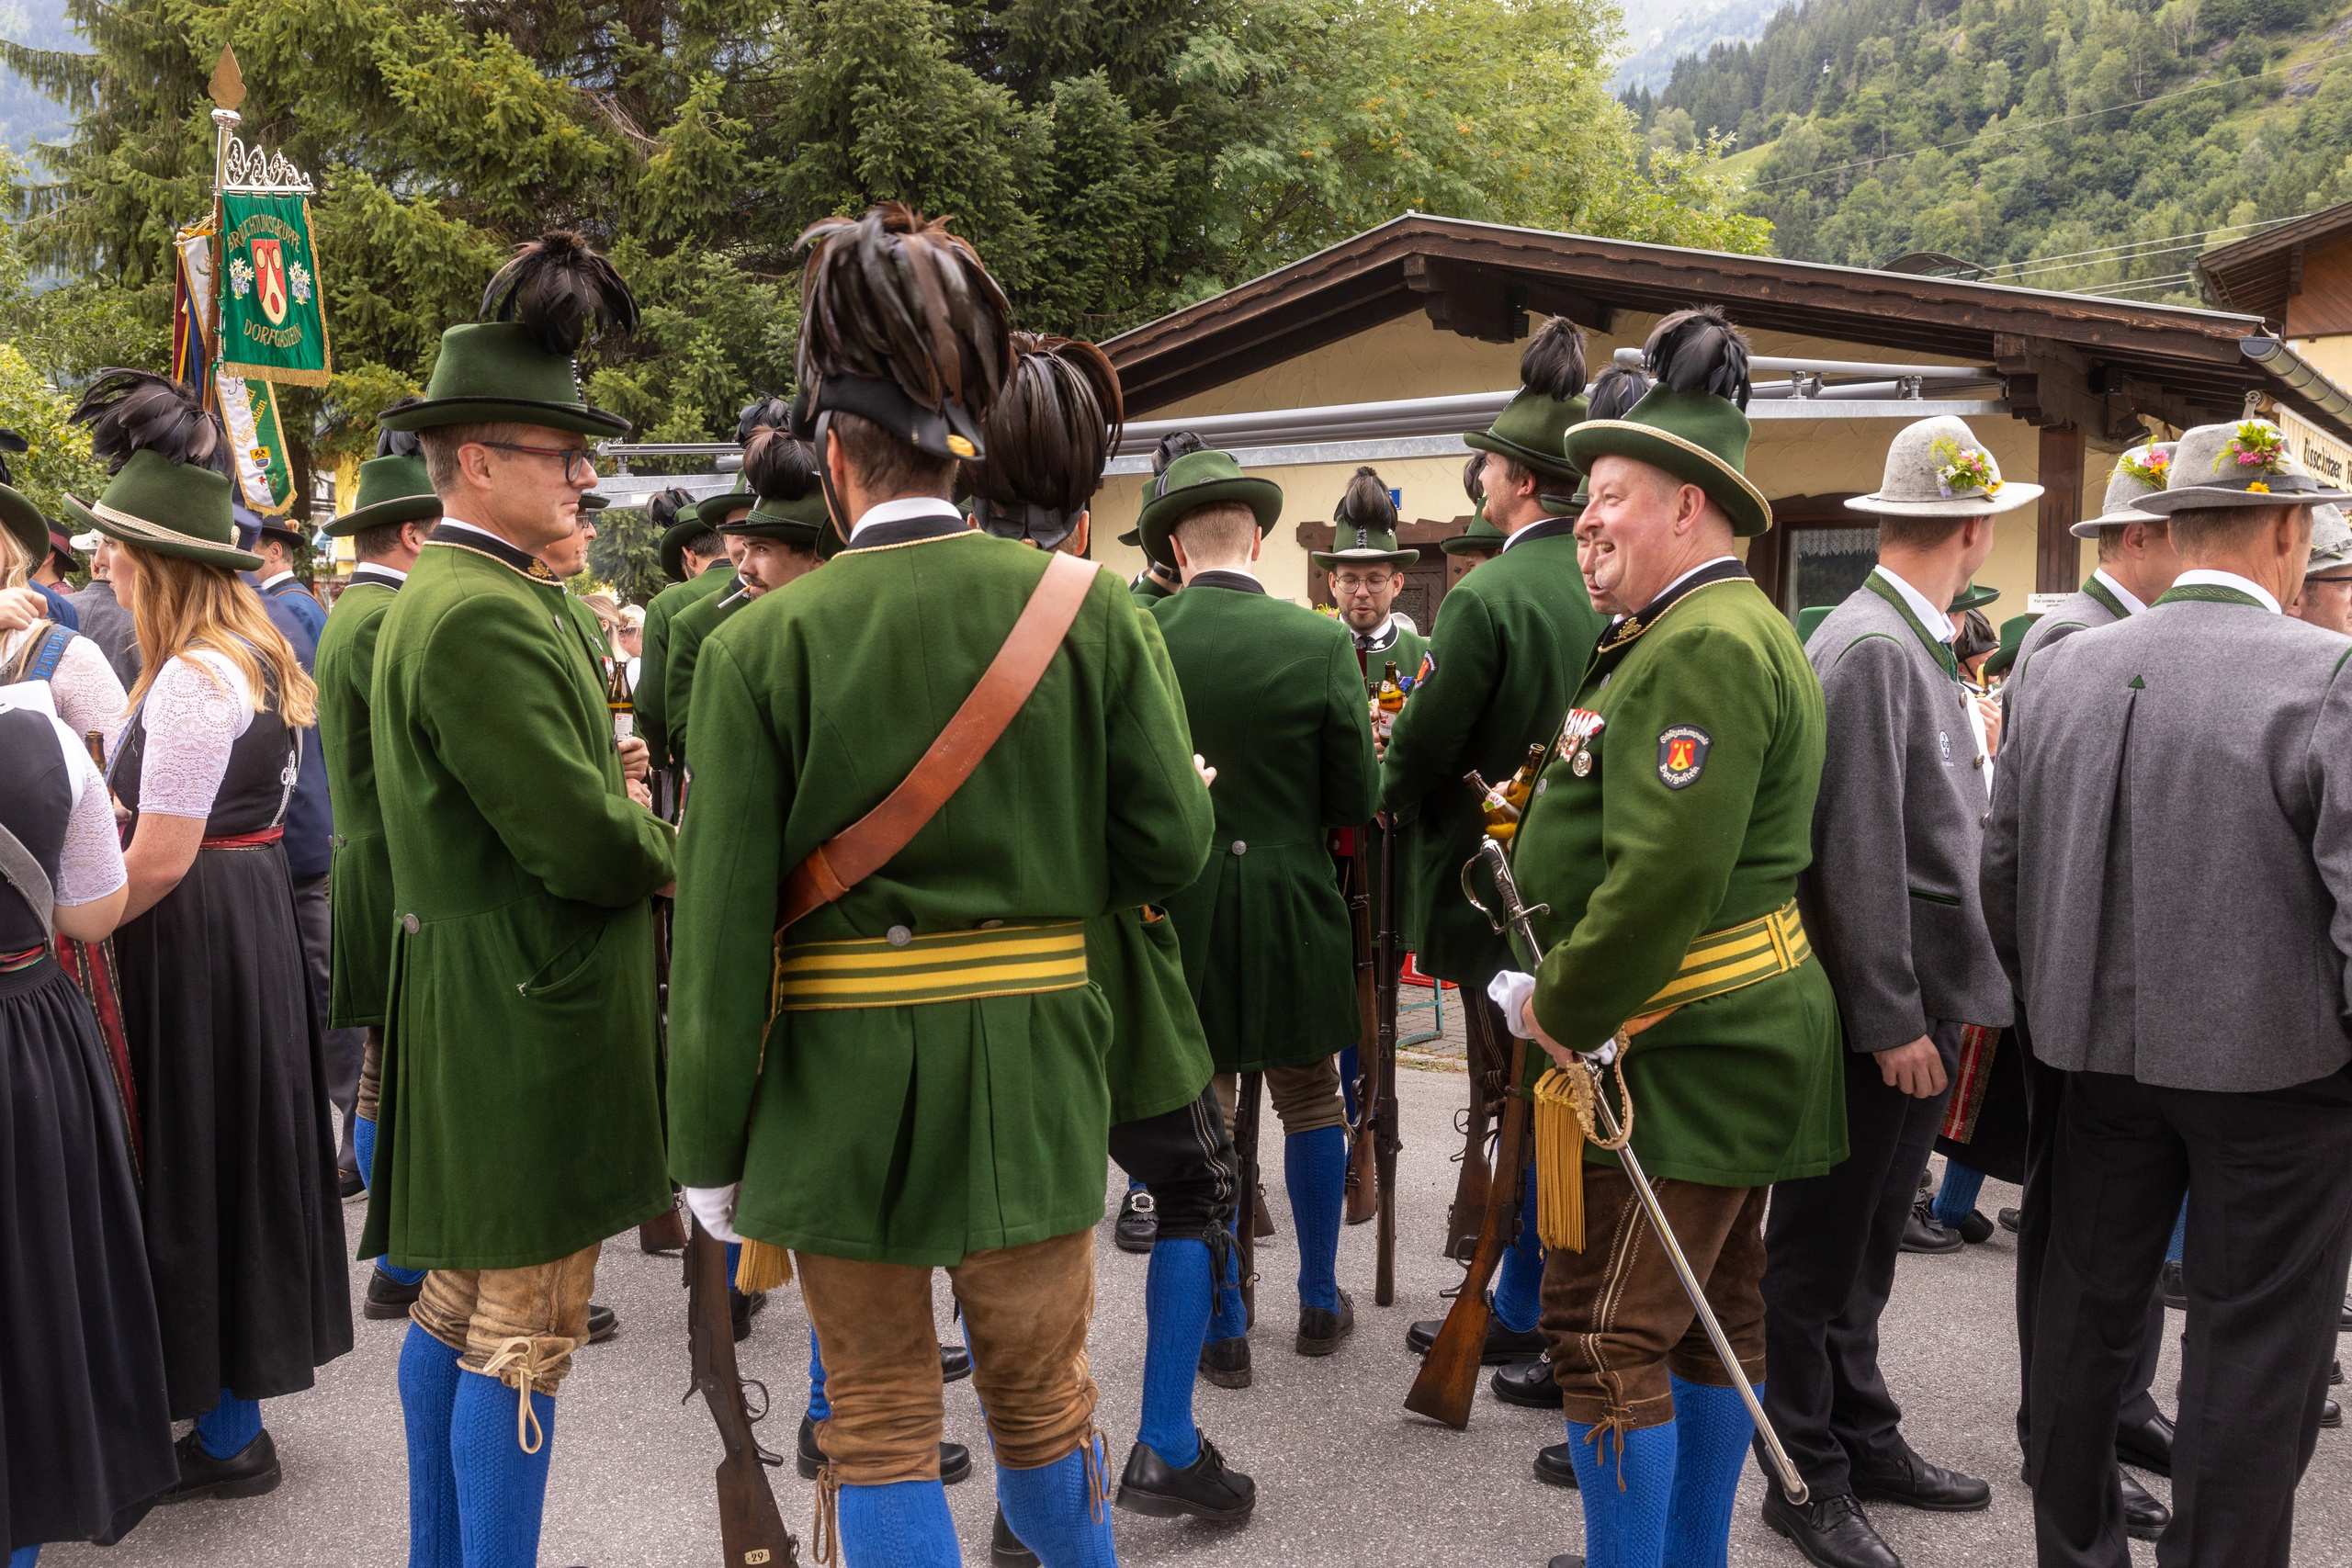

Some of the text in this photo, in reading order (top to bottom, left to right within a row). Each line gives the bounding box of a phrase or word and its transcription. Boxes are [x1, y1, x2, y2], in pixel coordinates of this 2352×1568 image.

[243, 318, 303, 348] DORFGASTEIN
[236, 387, 256, 412] Bad
[751, 1551, 763, 1562] 29
